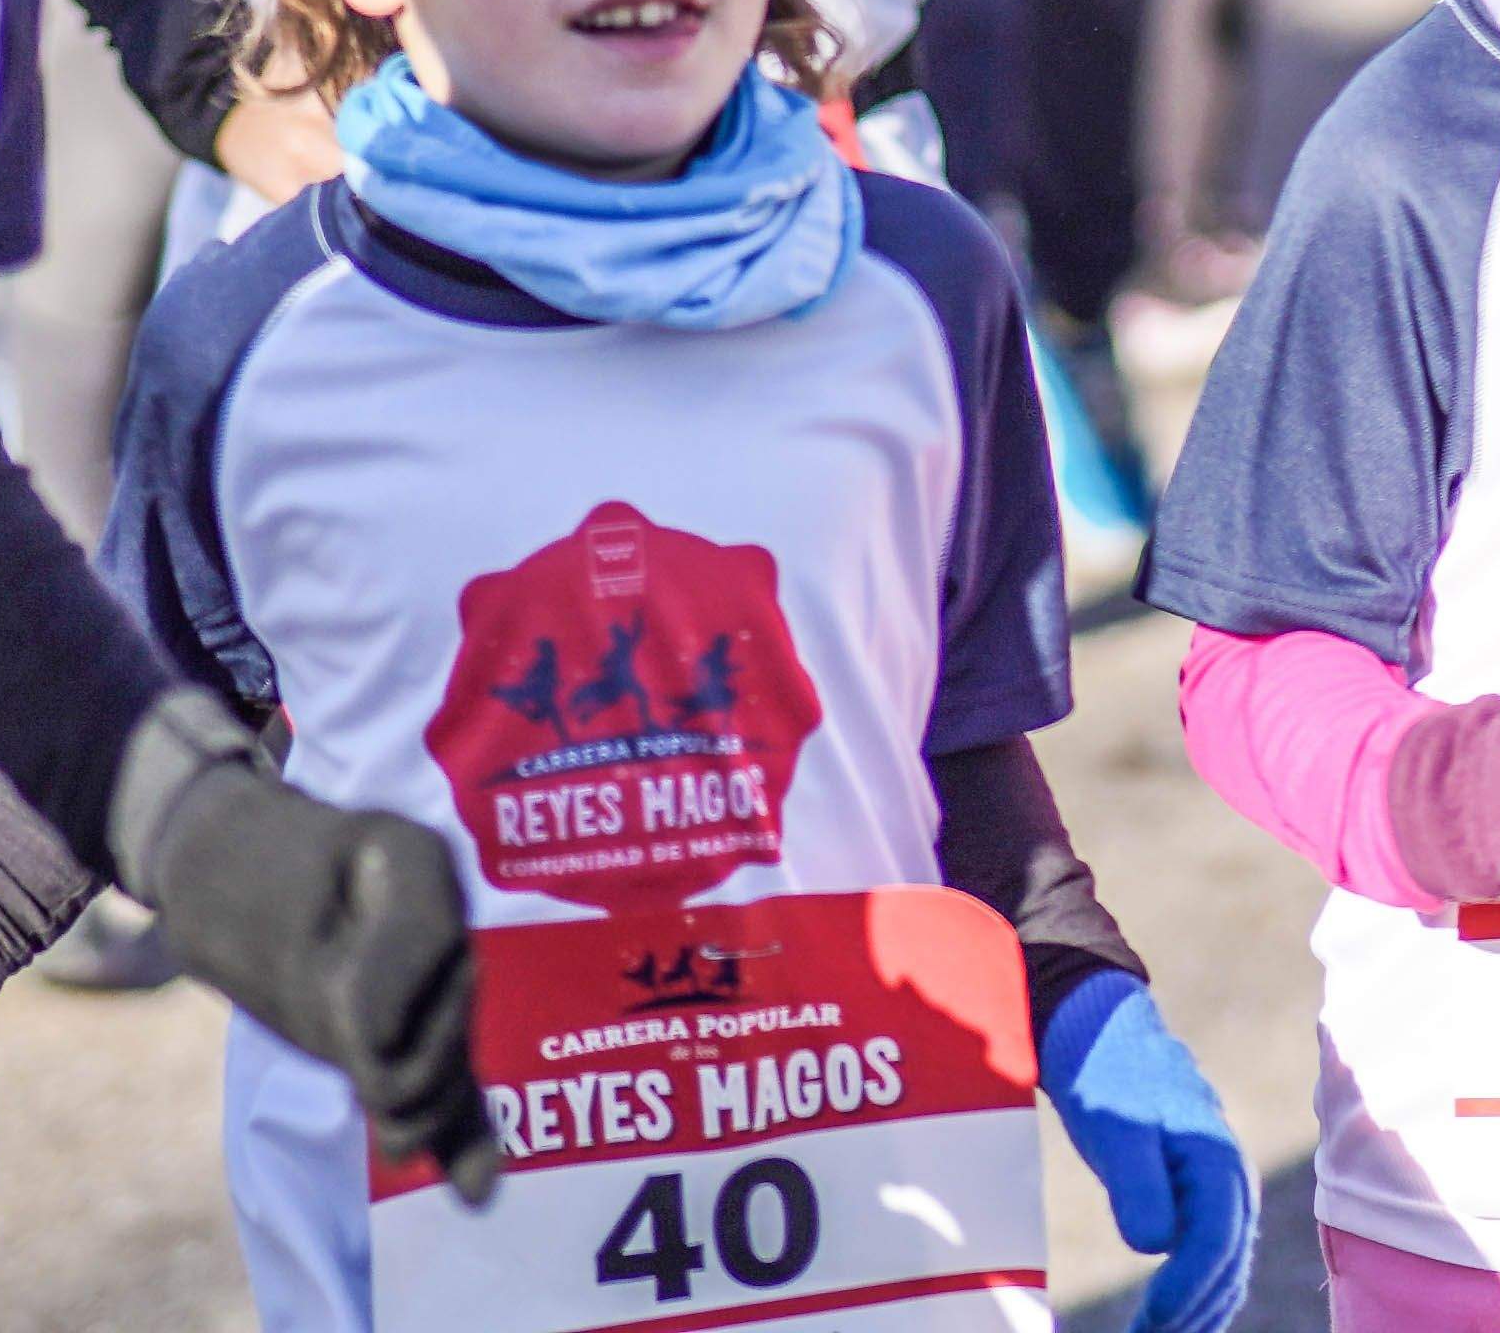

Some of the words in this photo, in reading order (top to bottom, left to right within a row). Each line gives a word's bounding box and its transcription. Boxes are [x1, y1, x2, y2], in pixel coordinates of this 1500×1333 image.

[516, 737, 631, 777] CARRERA
[494, 783, 624, 847] REYES
[651, 843, 684, 863] DE
[539, 1016, 688, 1061] CARRERA
[697, 1003, 841, 1039] POPULAR
[669, 1045, 691, 1061] de
[484, 1069, 673, 1158] REYES
[697, 1035, 901, 1140] MAGOS
[595, 1156, 820, 1303] 40
